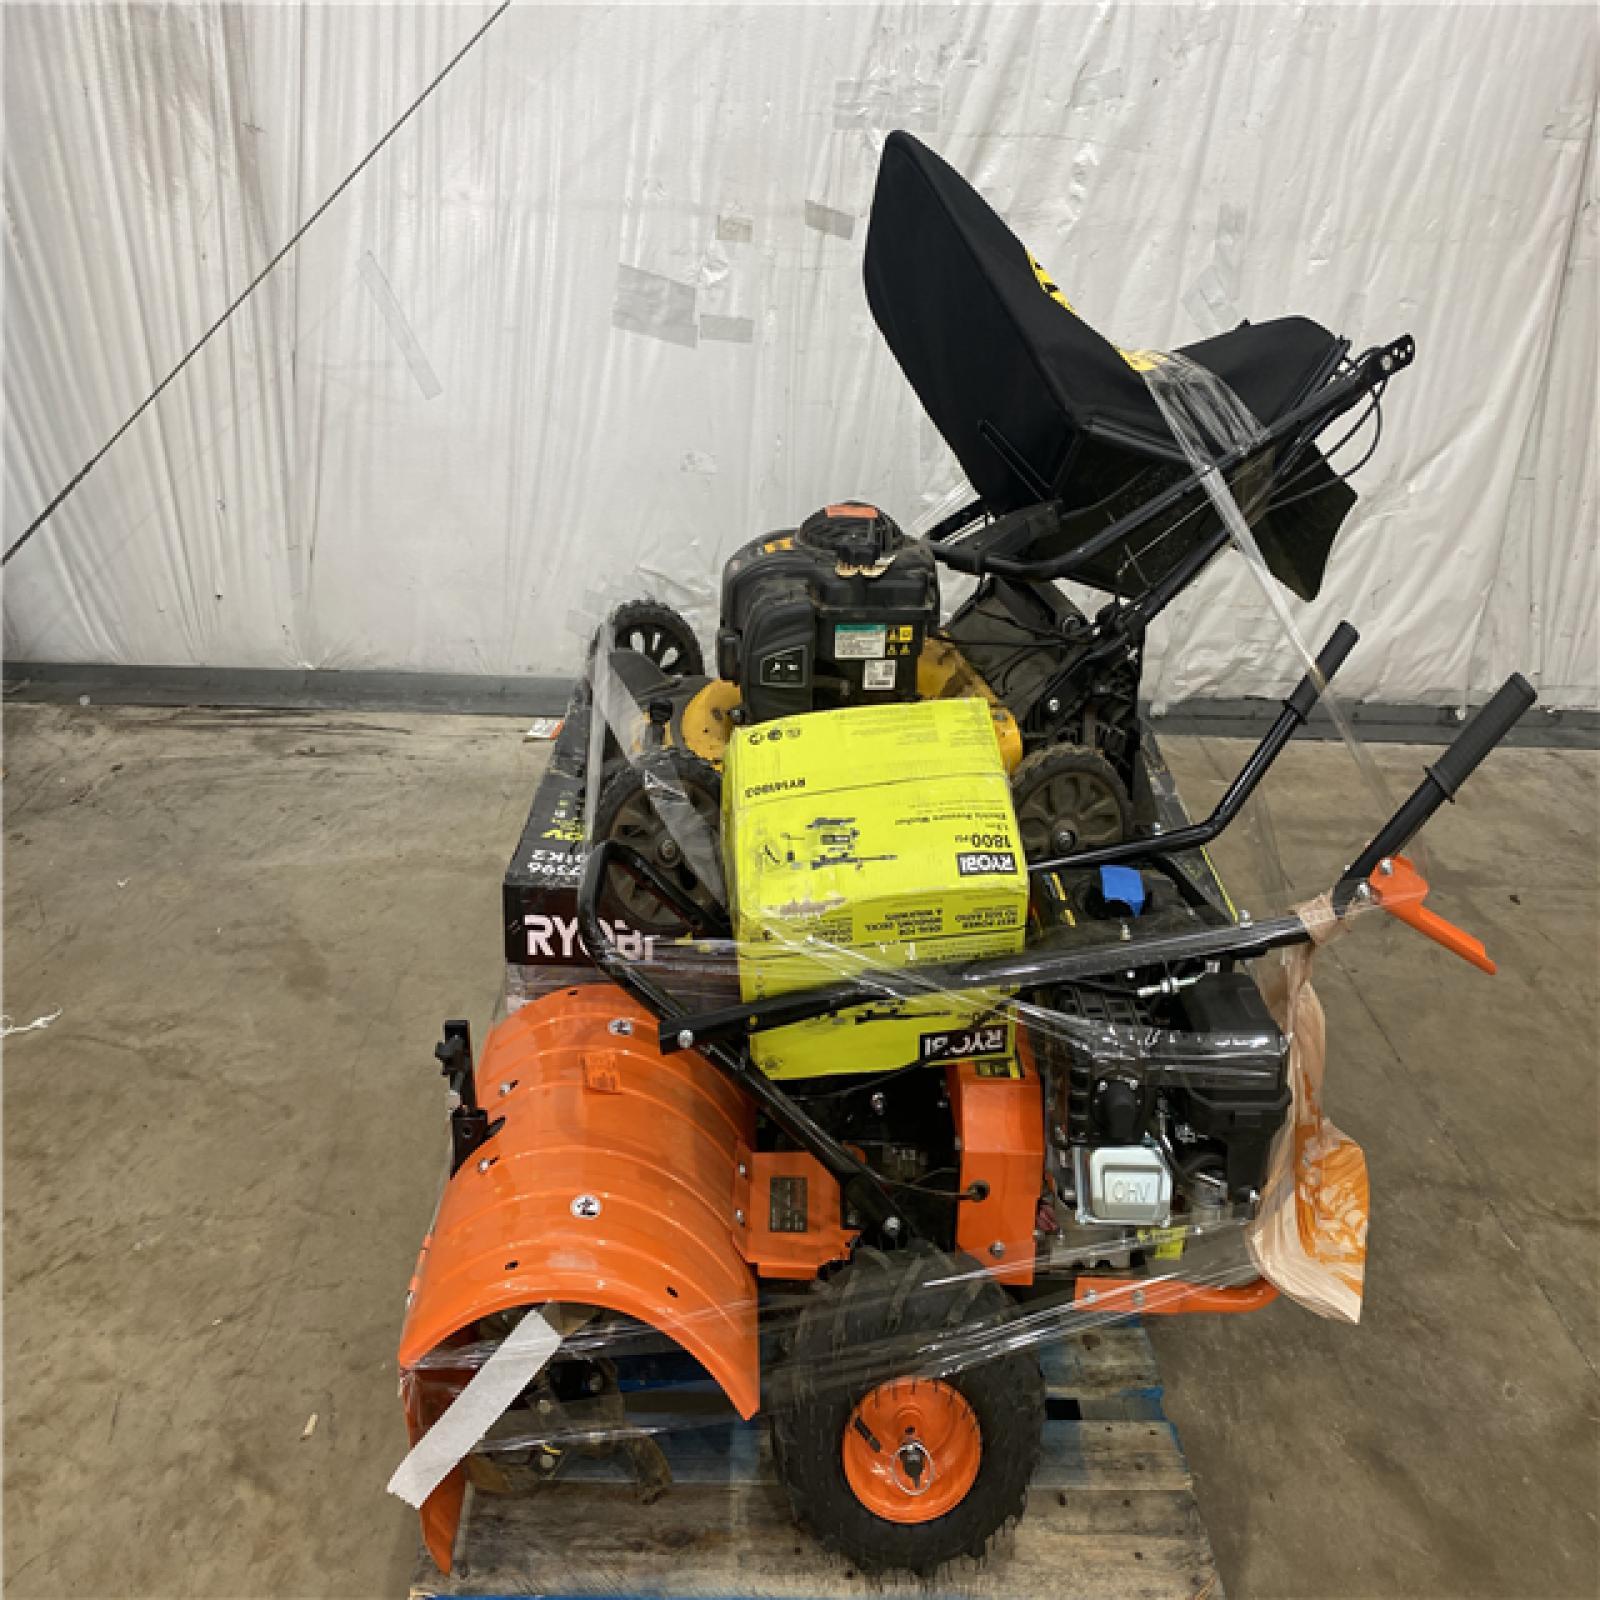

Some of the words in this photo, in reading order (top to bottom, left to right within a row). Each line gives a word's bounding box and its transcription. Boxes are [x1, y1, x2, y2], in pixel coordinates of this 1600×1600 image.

[971, 833, 1012, 848] 1800
[959, 854, 1016, 872] RYOBI
[524, 915, 653, 960] RYBI
